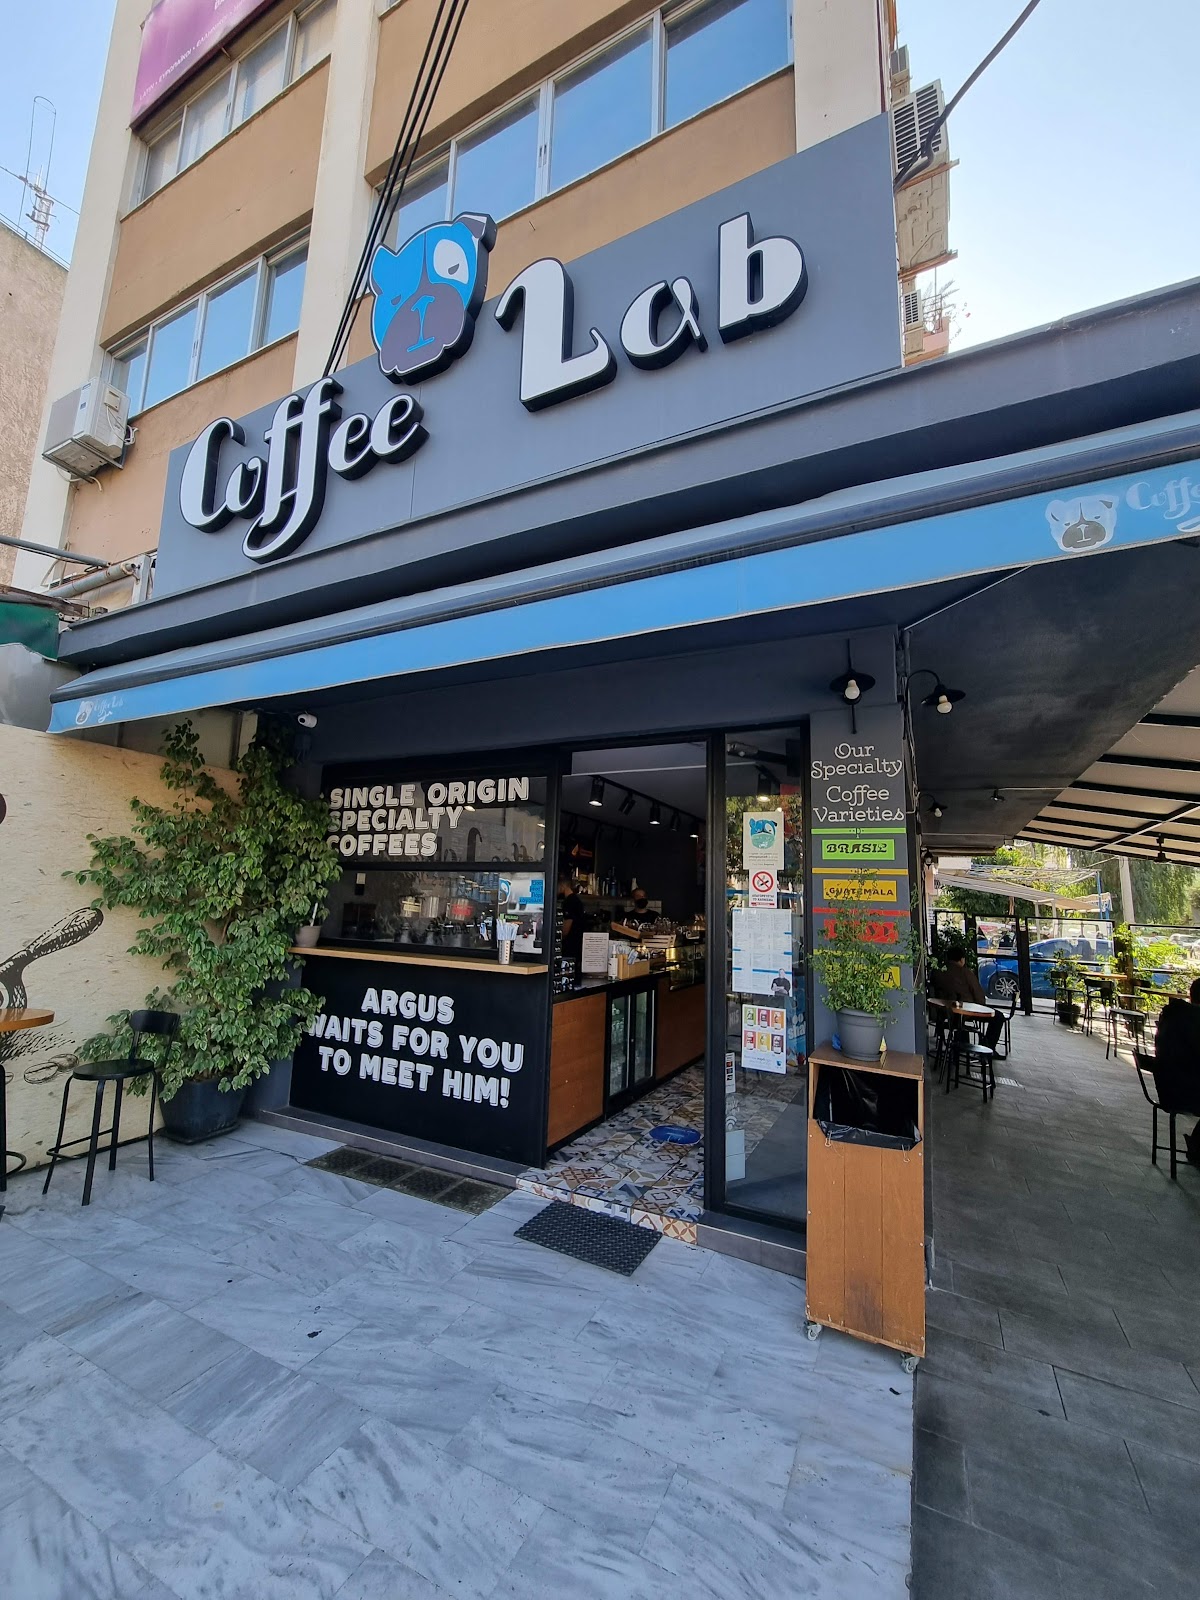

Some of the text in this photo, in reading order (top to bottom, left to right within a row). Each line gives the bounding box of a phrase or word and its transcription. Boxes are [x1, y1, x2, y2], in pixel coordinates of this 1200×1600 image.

[180, 212, 808, 563] Coffee Lab
[834, 743, 875, 759] Our
[811, 758, 903, 780] Specialty
[329, 777, 529, 810] SINGLE ORIGIN
[826, 784, 889, 806] Coffee
[327, 806, 463, 832] SPECIALTY
[813, 806, 905, 822] Varieties
[326, 832, 437, 857] COFFEES
[826, 843, 888, 854] BRASIL
[361, 987, 455, 1025] ARGUS
[308, 1013, 524, 1072] WAITS FOR YOU
[318, 1046, 511, 1108] TO MEET HIM!
